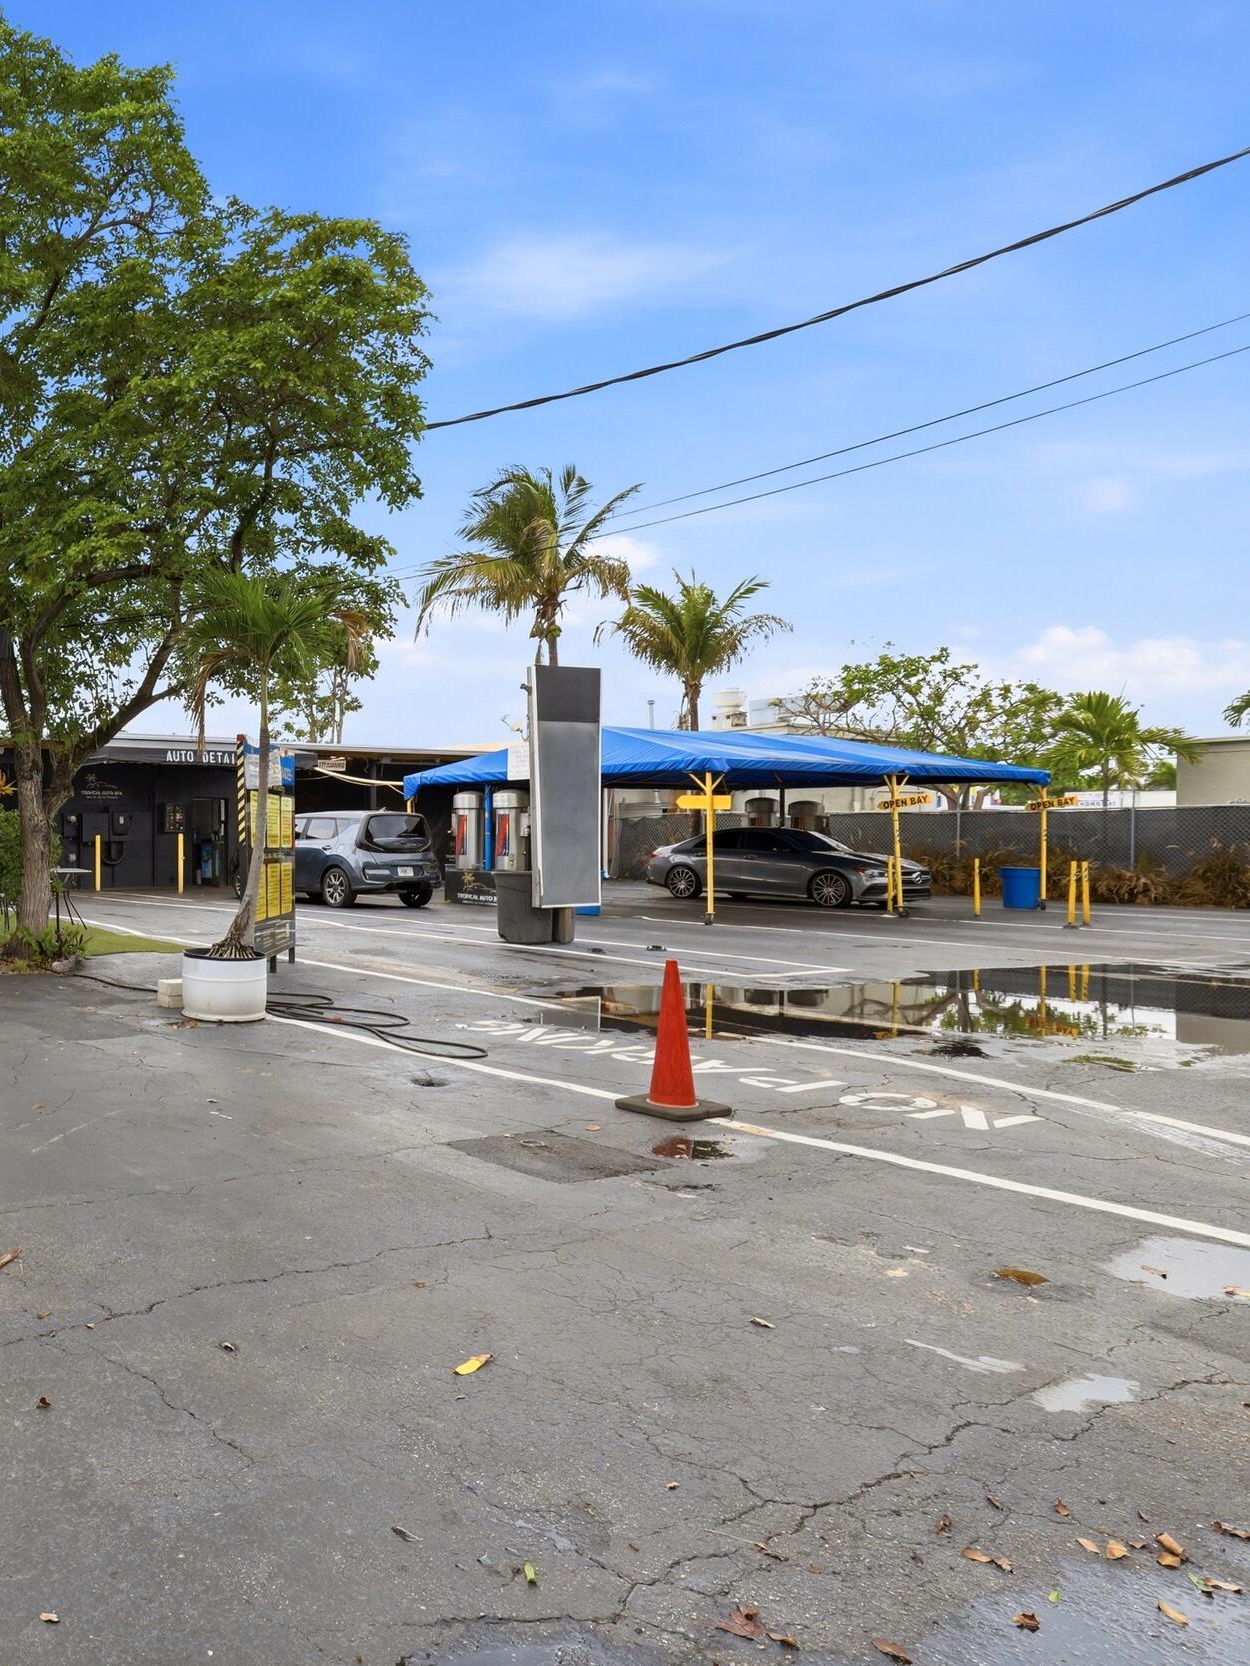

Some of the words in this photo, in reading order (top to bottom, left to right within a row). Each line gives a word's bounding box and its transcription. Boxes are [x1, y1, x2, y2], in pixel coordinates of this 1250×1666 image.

[166, 750, 194, 762] AUTO
[202, 752, 235, 765] DETAI
[883, 798, 907, 809] OPEN
[910, 795, 928, 806] BAY
[1030, 800, 1054, 811] OPEN
[1057, 797, 1075, 807] BAY
